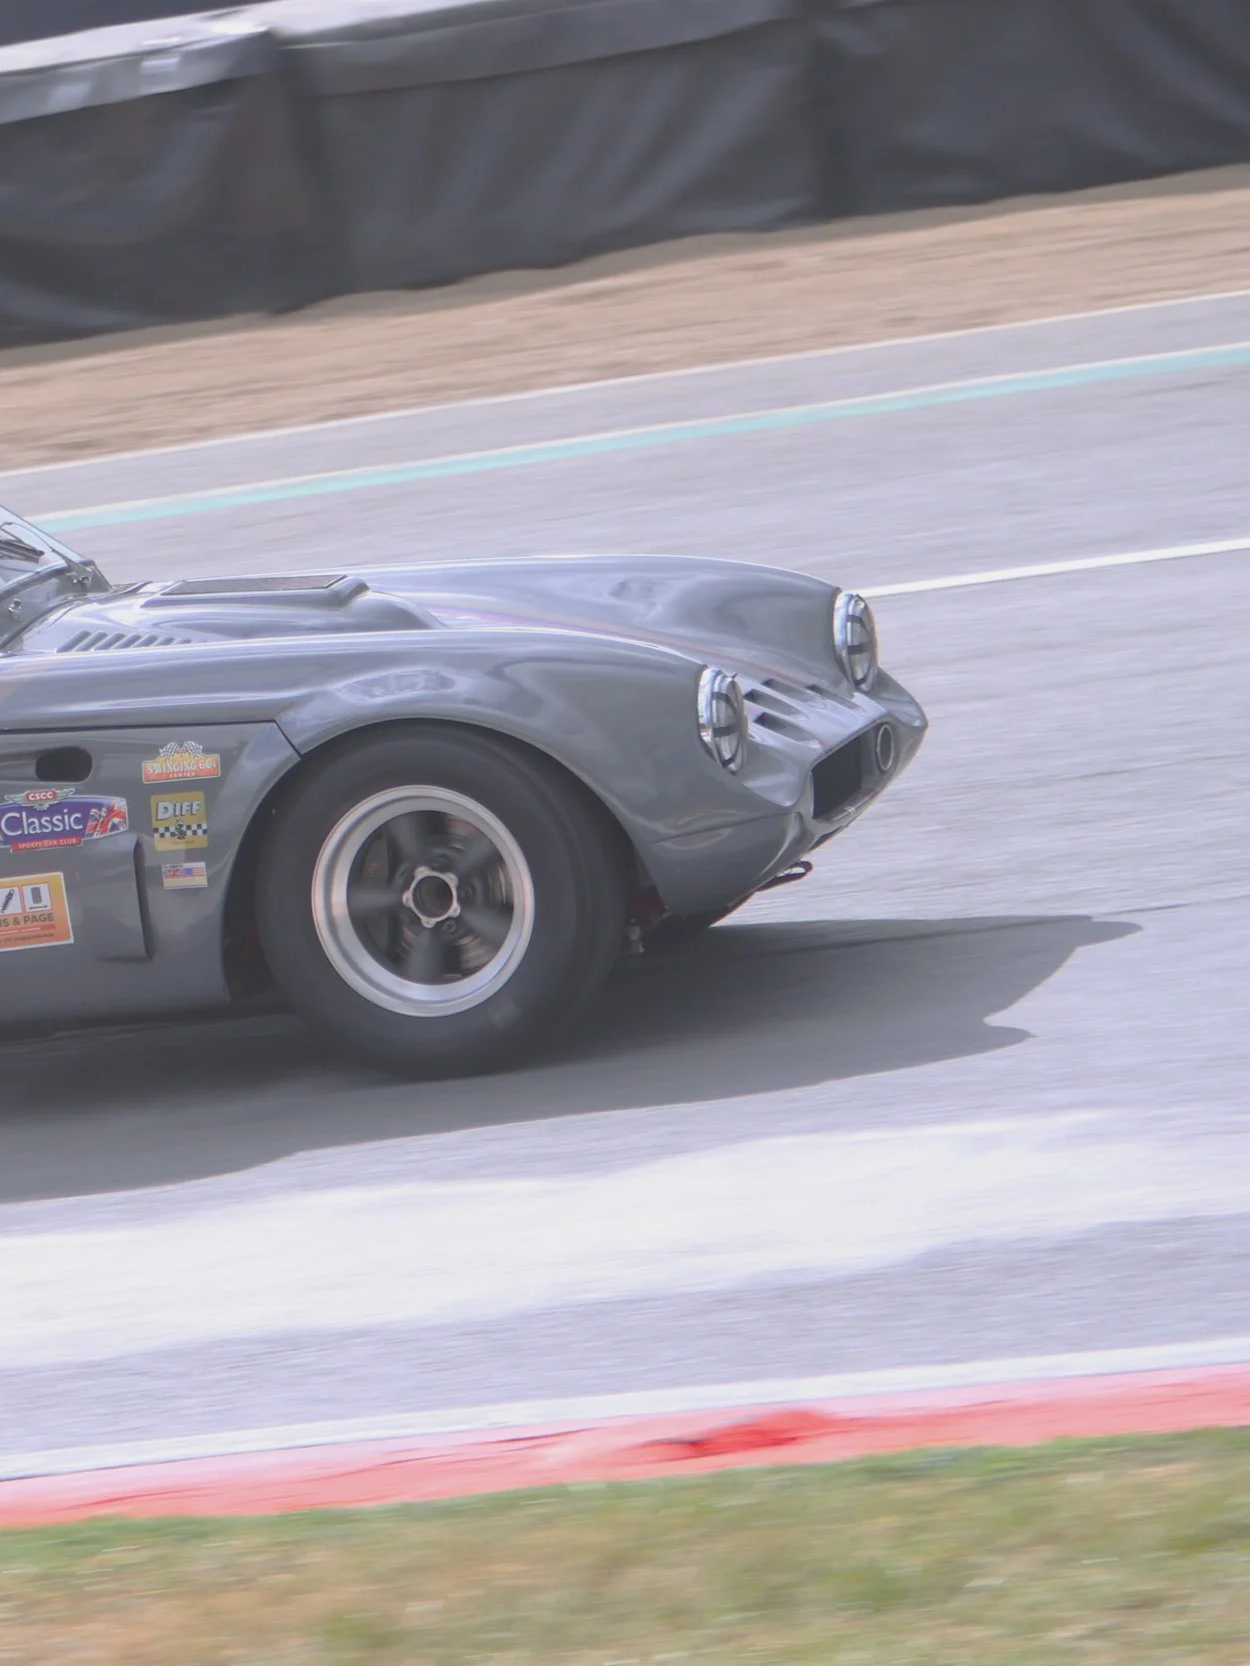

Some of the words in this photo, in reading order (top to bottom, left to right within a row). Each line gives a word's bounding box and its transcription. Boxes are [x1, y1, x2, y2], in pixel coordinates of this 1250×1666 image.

[28, 791, 55, 801] CSCC
[156, 801, 202, 821] DIFF
[0, 808, 83, 836] Classic
[13, 917, 21, 926] &
[23, 912, 55, 925] PAGE
